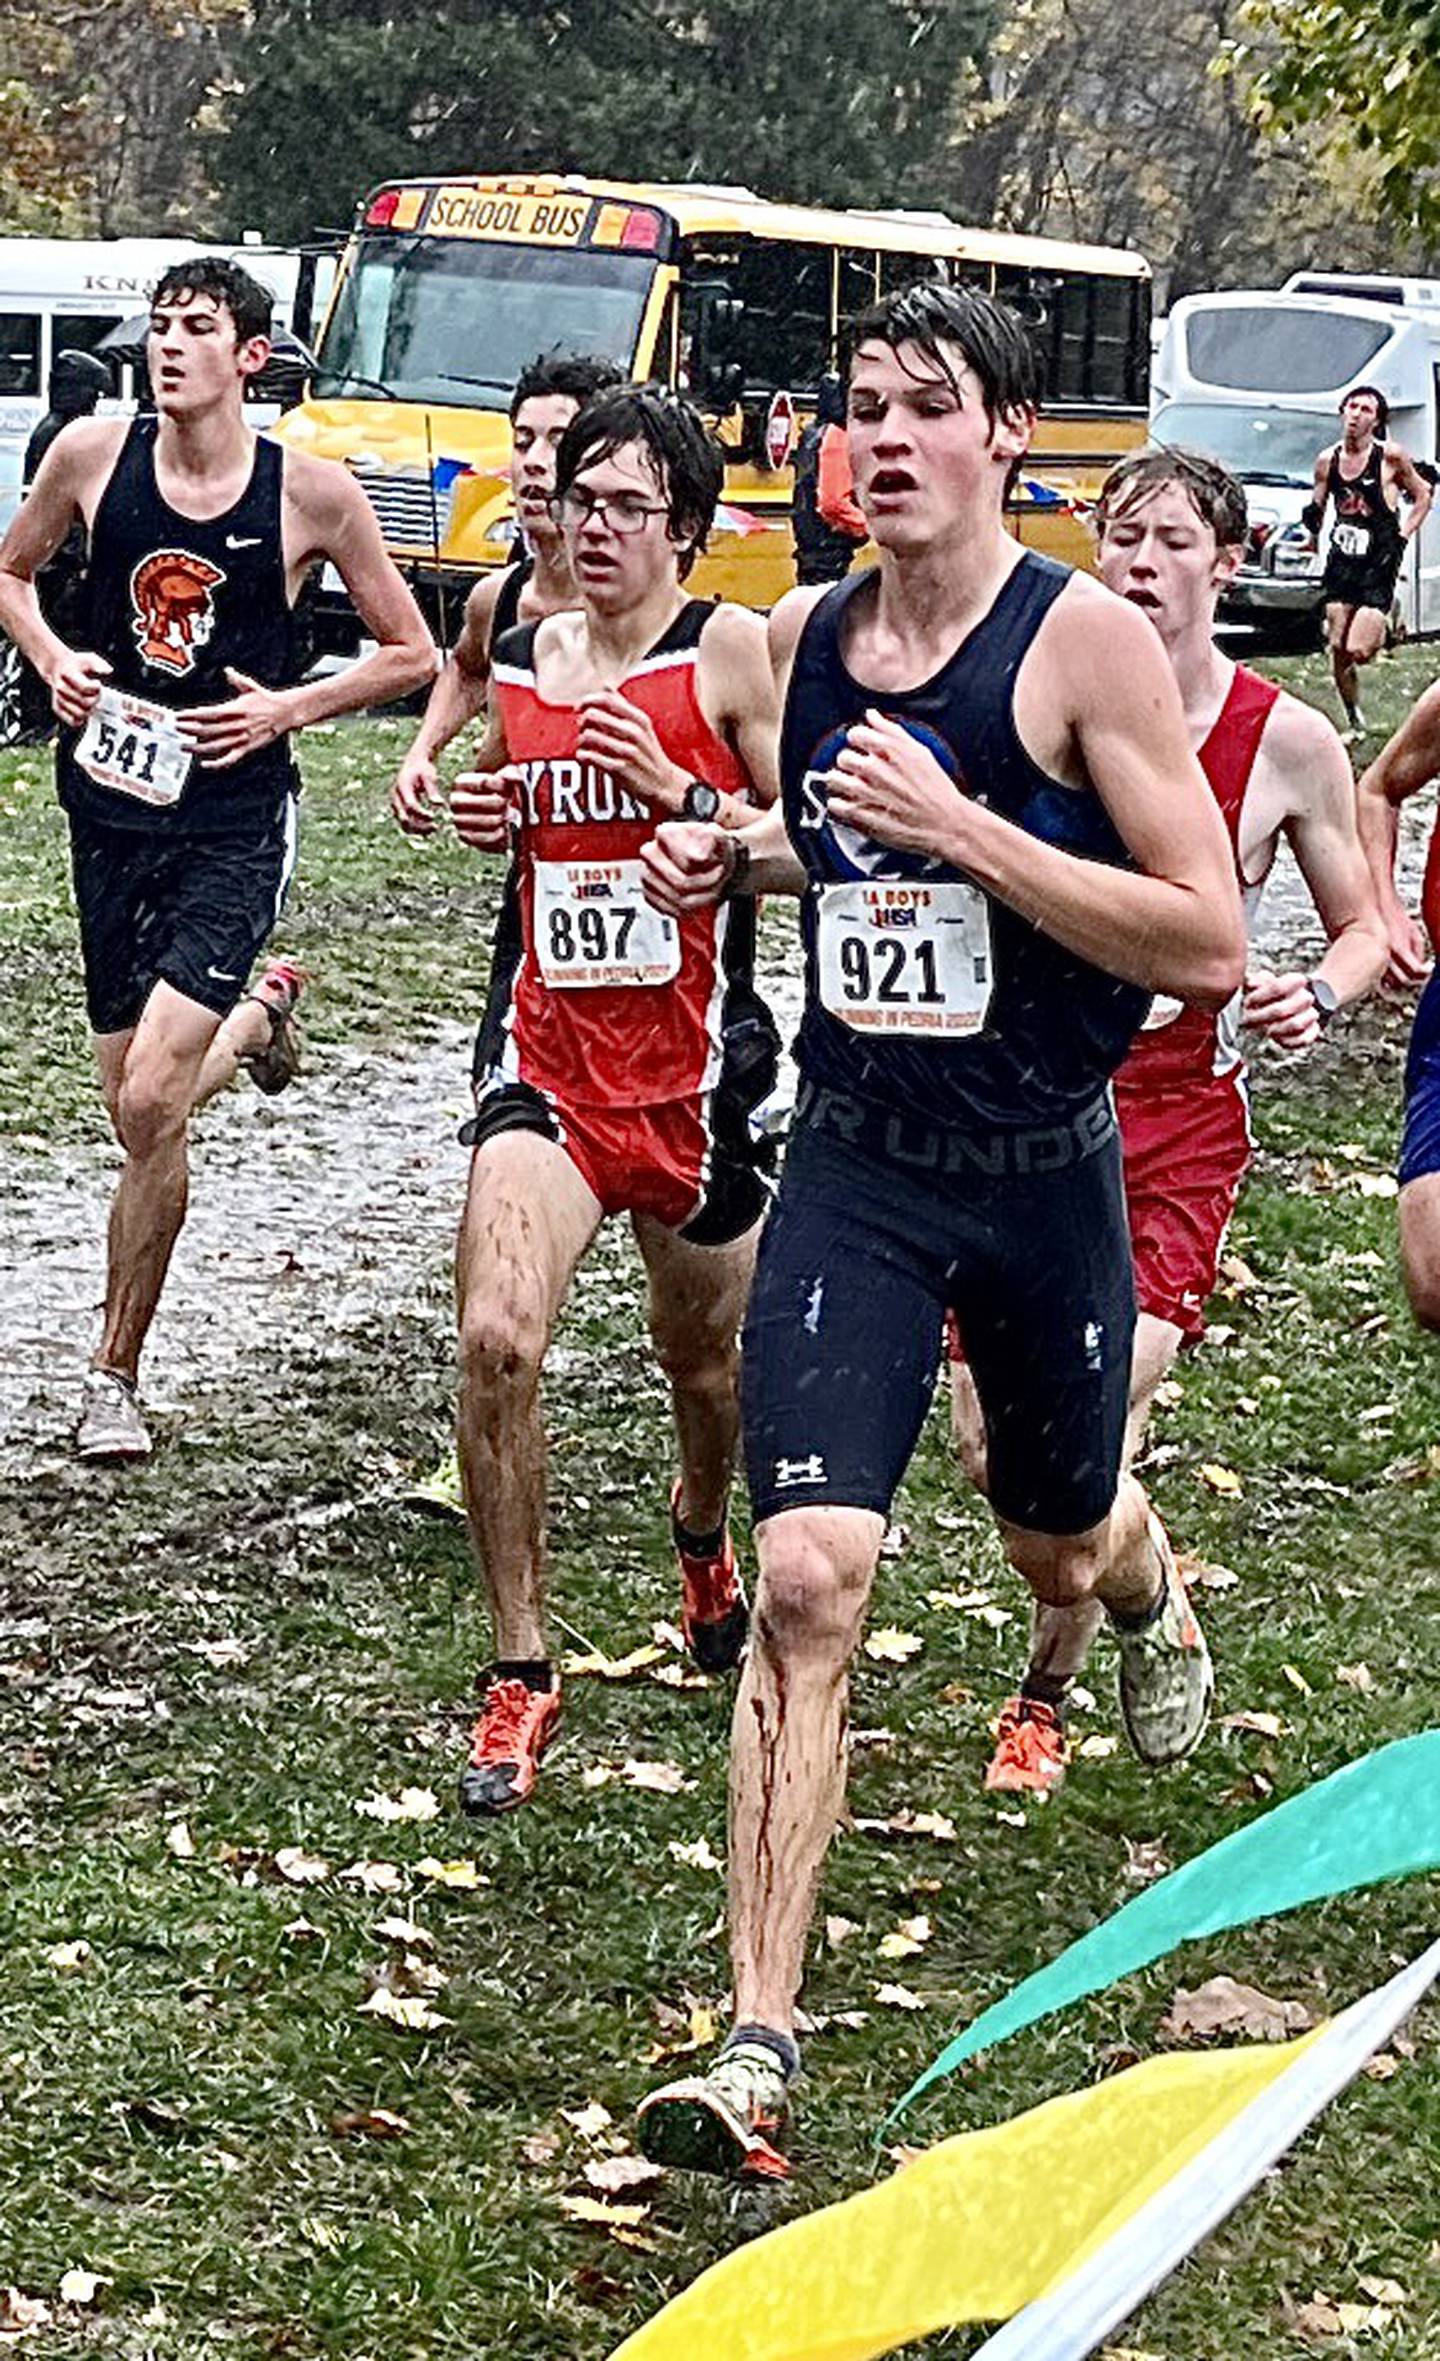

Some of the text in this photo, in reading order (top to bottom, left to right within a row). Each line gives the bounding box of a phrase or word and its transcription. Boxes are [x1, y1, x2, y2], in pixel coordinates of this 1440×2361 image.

[430, 196, 584, 239] SCHOOL BUS
[91, 722, 158, 784] 541
[885, 890, 932, 908] BOYS
[548, 906, 637, 962] 897
[841, 936, 946, 1004] 921
